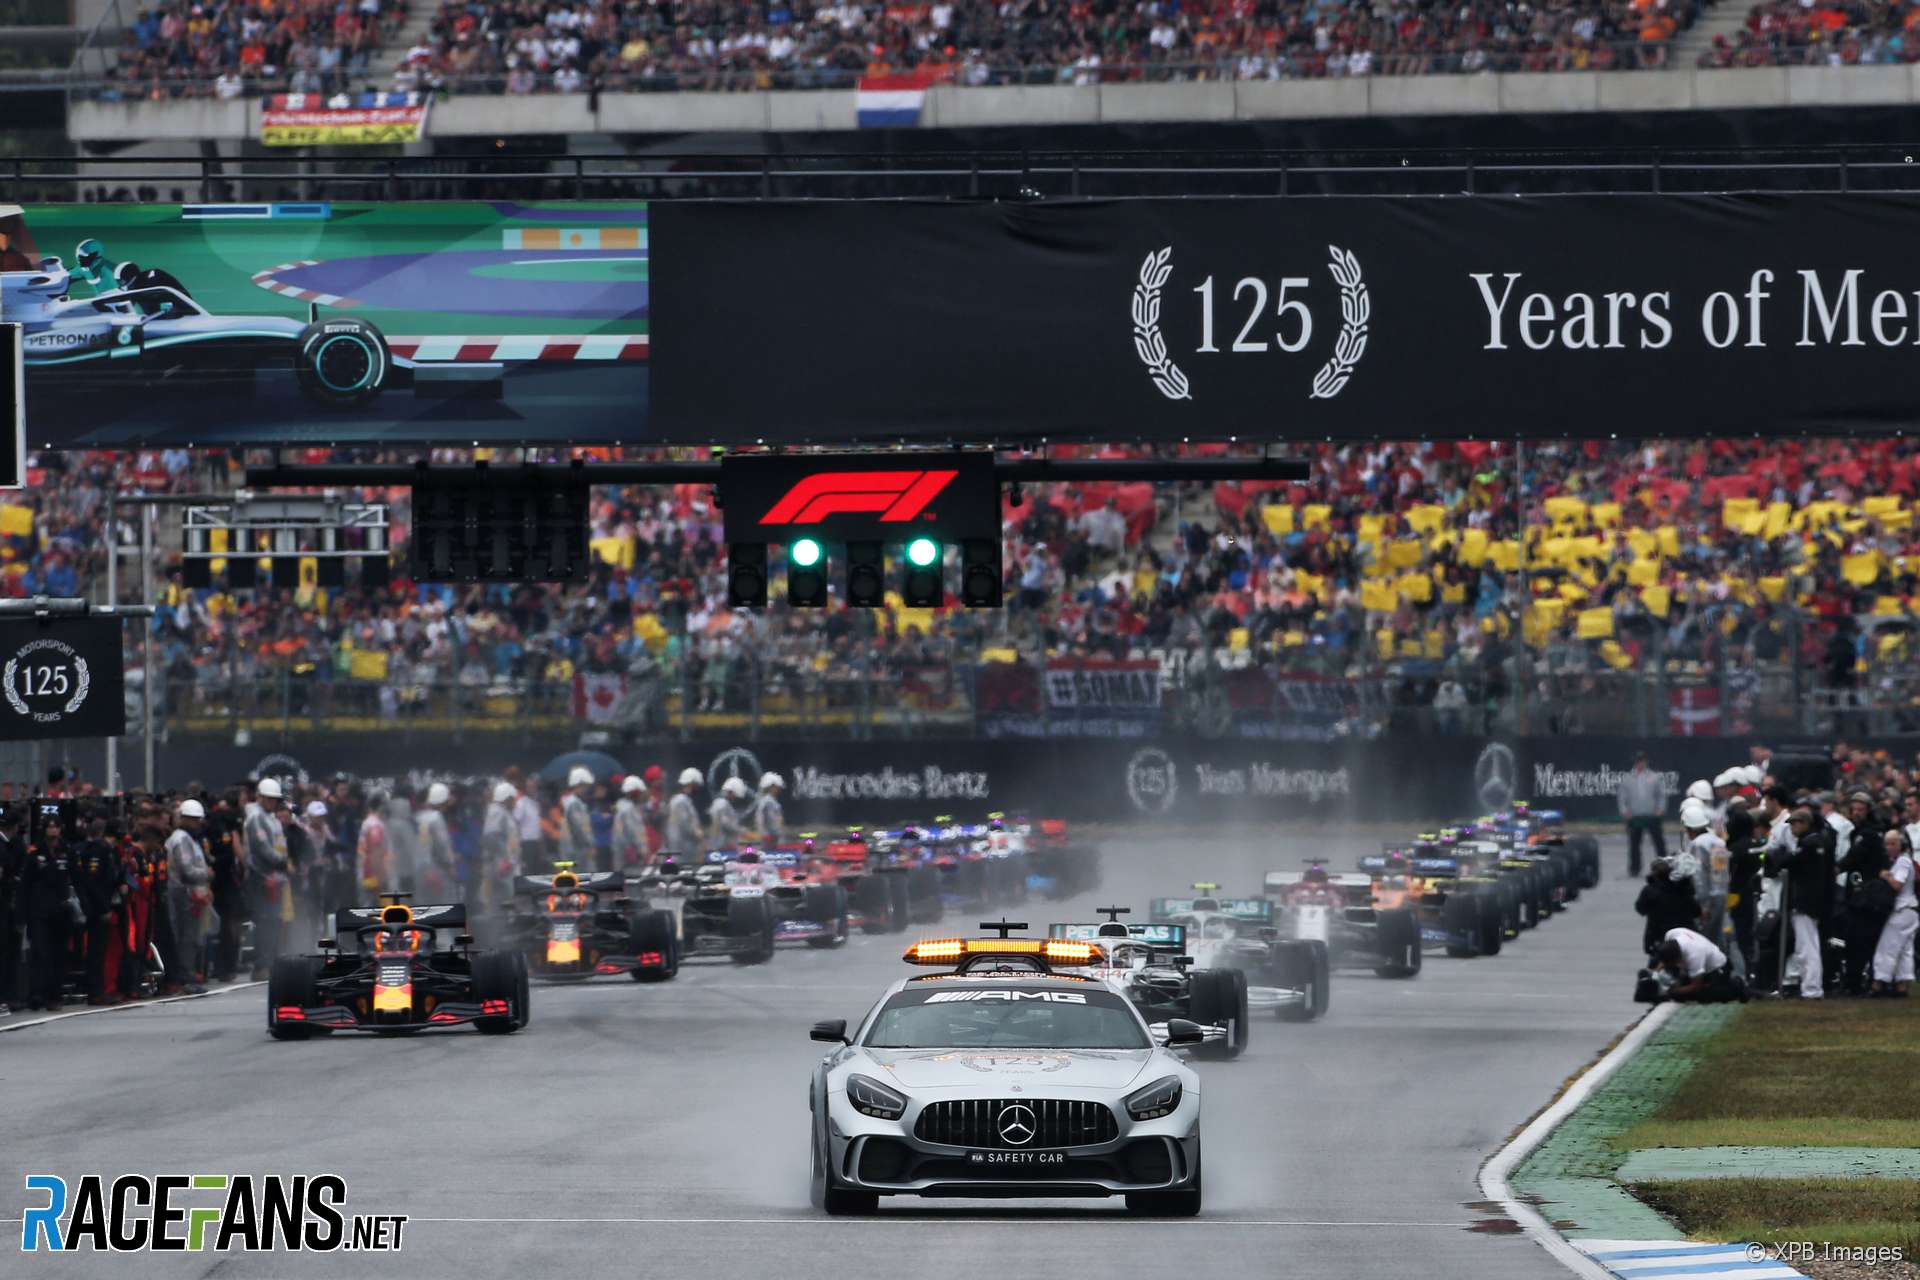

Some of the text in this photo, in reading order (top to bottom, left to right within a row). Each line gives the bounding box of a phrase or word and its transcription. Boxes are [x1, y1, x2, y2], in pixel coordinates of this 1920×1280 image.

[1193, 275, 1313, 353] 125
[1469, 268, 1920, 350] Years of Me
[29, 333, 101, 346] PETRONA
[16, 639, 76, 658] MOTORSPORT
[22, 665, 69, 696] 125
[33, 711, 62, 722] YEARS
[969, 991, 1087, 1004] AMG
[987, 1153, 1034, 1163] SAFETY
[1039, 1153, 1064, 1163] CAR
